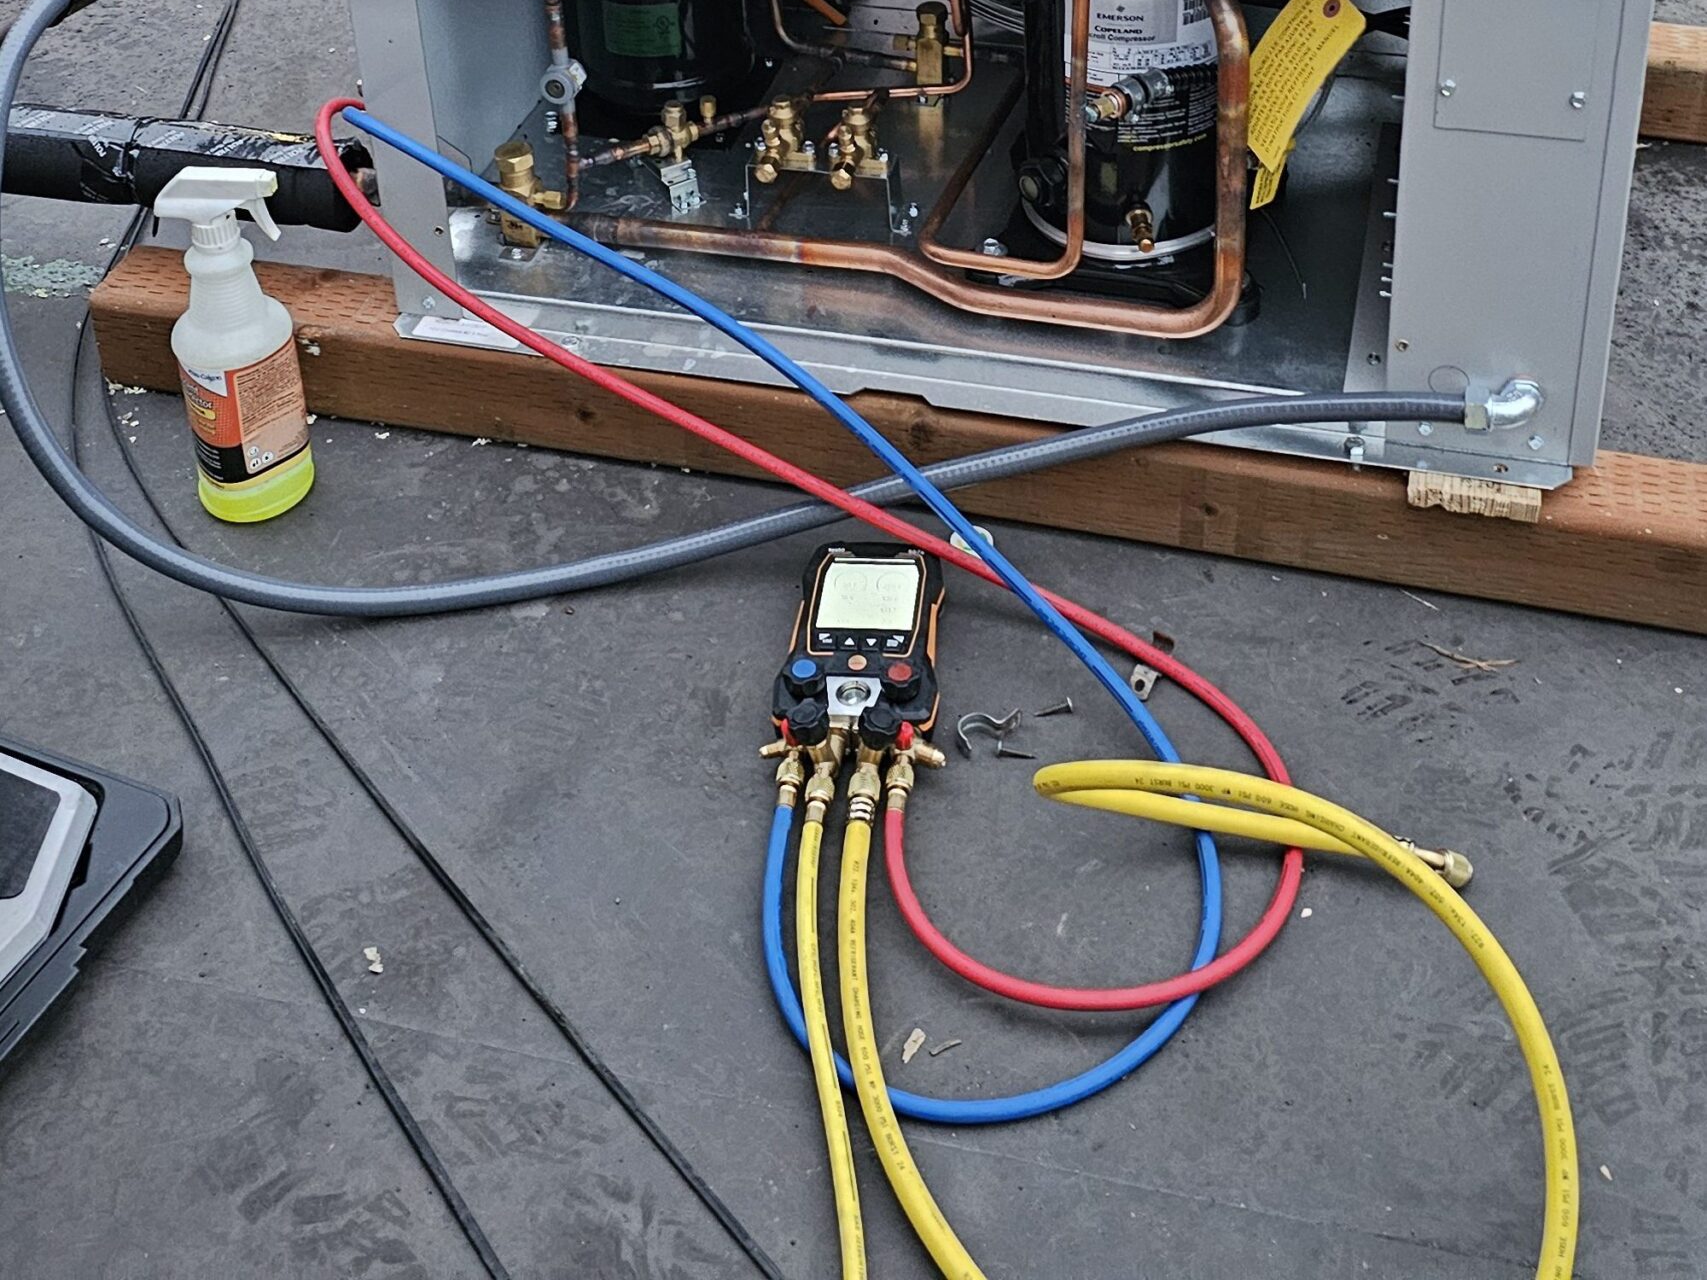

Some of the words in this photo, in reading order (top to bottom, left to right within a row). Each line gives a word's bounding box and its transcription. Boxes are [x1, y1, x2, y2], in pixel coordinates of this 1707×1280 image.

[1096, 13, 1144, 22] EMERSON
[1094, 26, 1142, 34] COPELAND
[1108, 34, 1156, 43] Compressor
[863, 1062, 873, 1075] PSI
